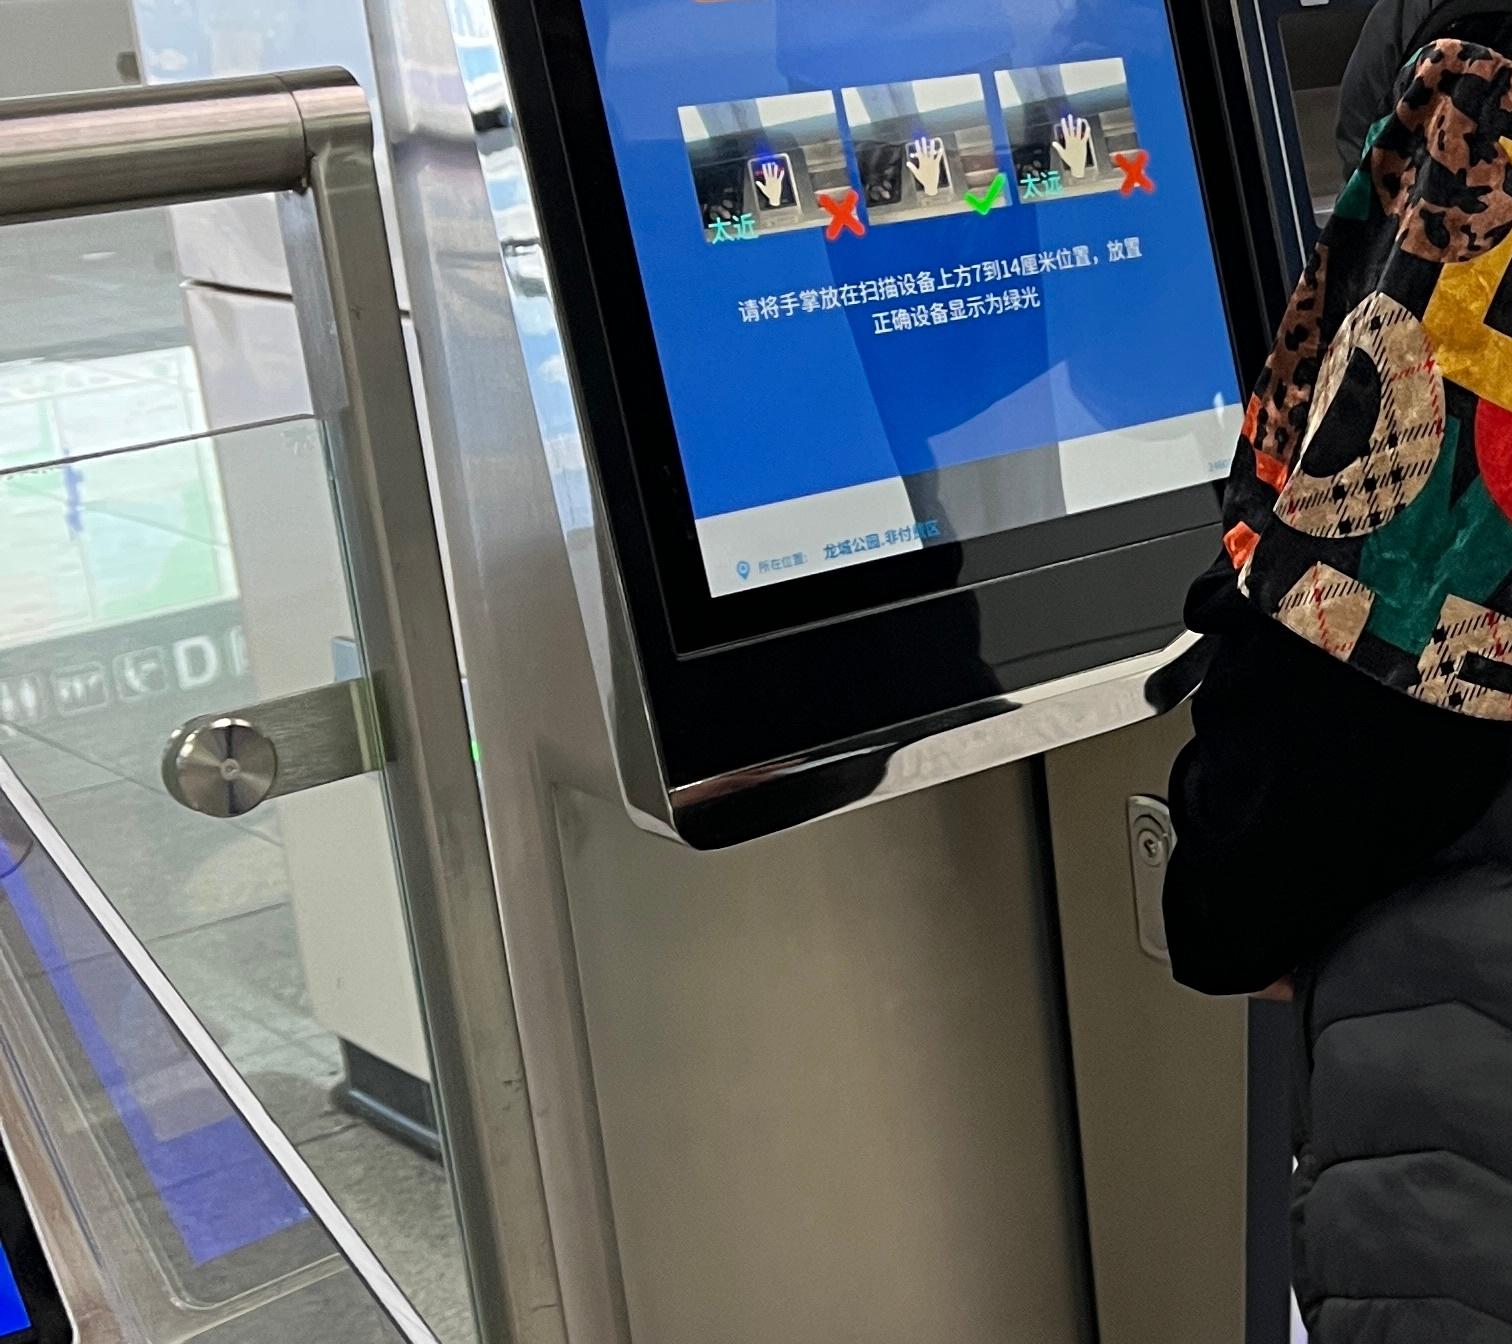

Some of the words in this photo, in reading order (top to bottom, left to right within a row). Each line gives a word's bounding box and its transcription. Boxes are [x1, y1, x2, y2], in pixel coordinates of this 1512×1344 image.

[1020, 170, 1064, 199] 太远
[708, 213, 759, 244] 太近
[873, 287, 1040, 335] 正确设备显示为绿光
